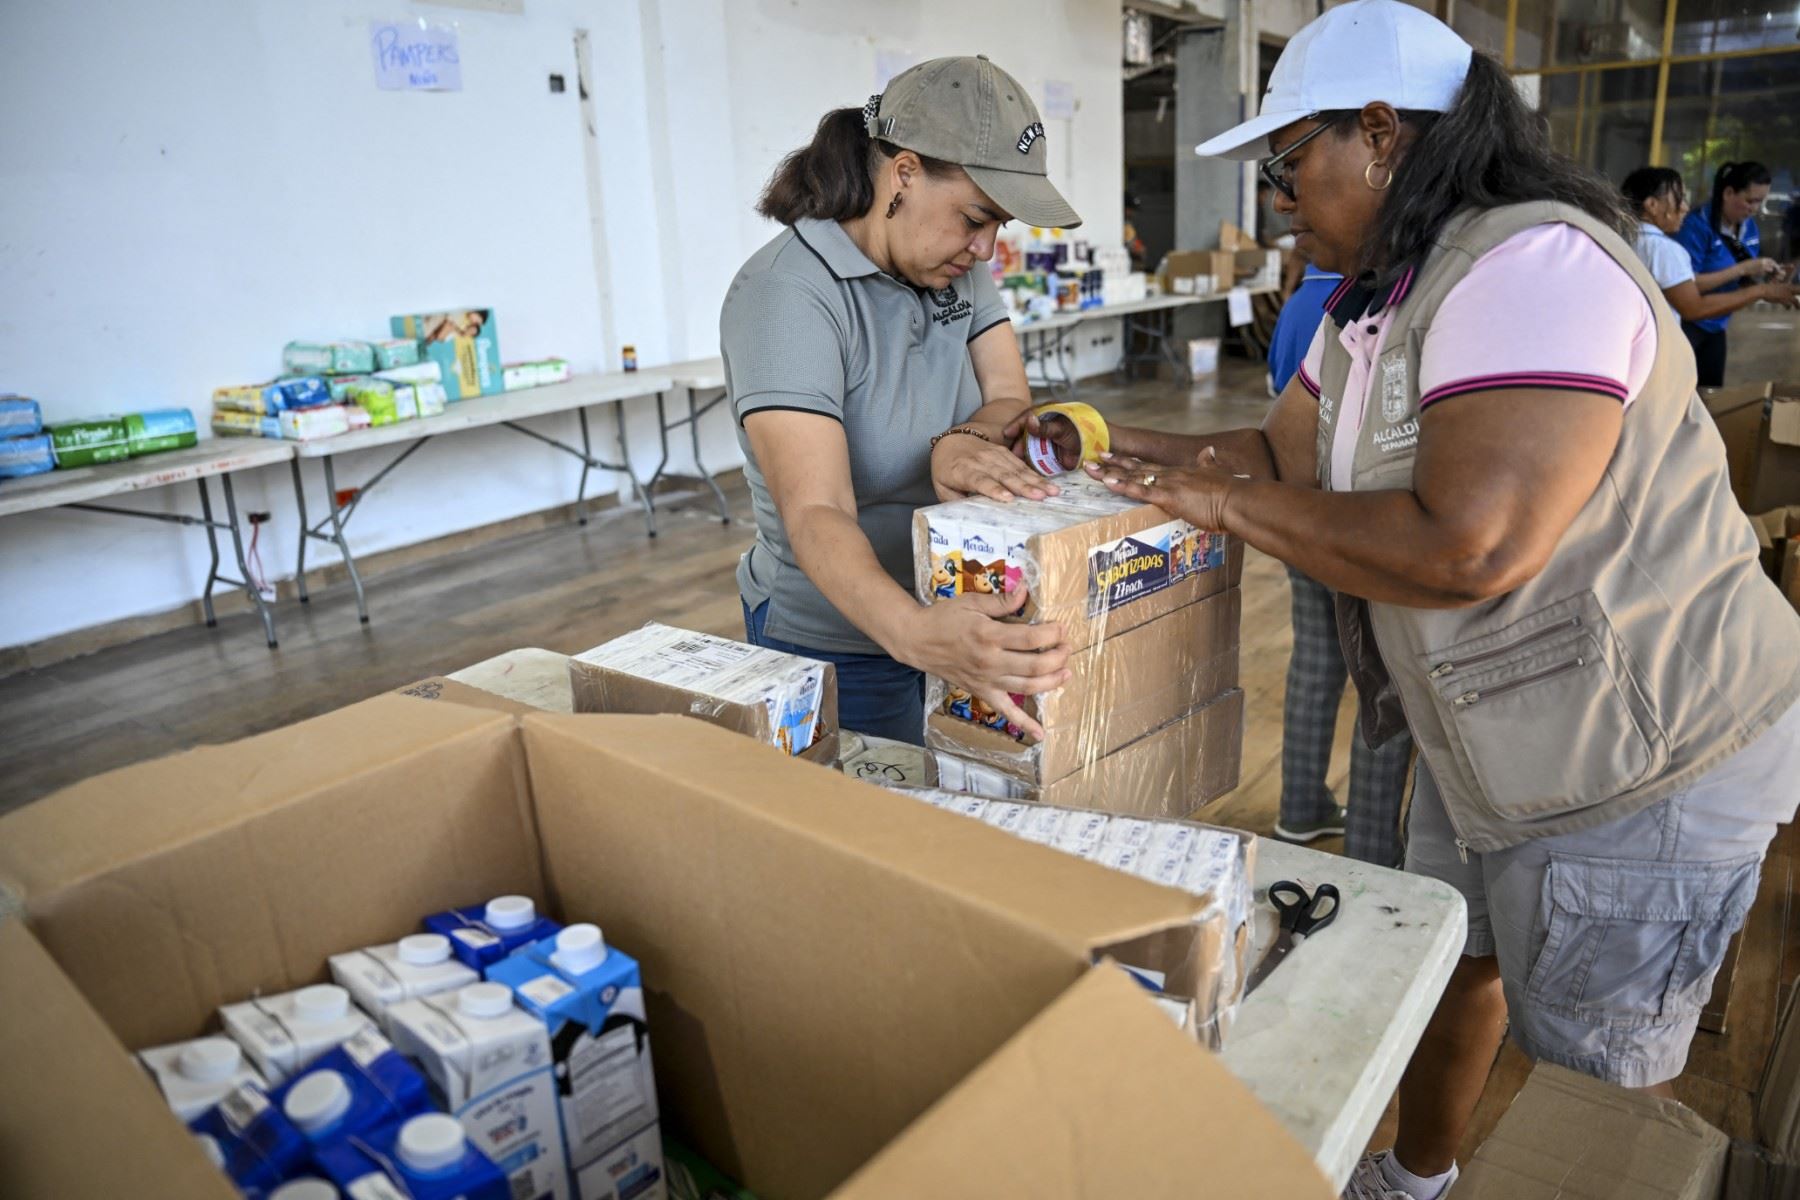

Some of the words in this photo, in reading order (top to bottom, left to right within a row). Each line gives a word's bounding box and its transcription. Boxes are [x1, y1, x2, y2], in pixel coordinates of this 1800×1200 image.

[1018, 126, 1036, 153] NEW
[1373, 417, 1420, 444] ALCALDÍ
[963, 538, 994, 554] Nevada
